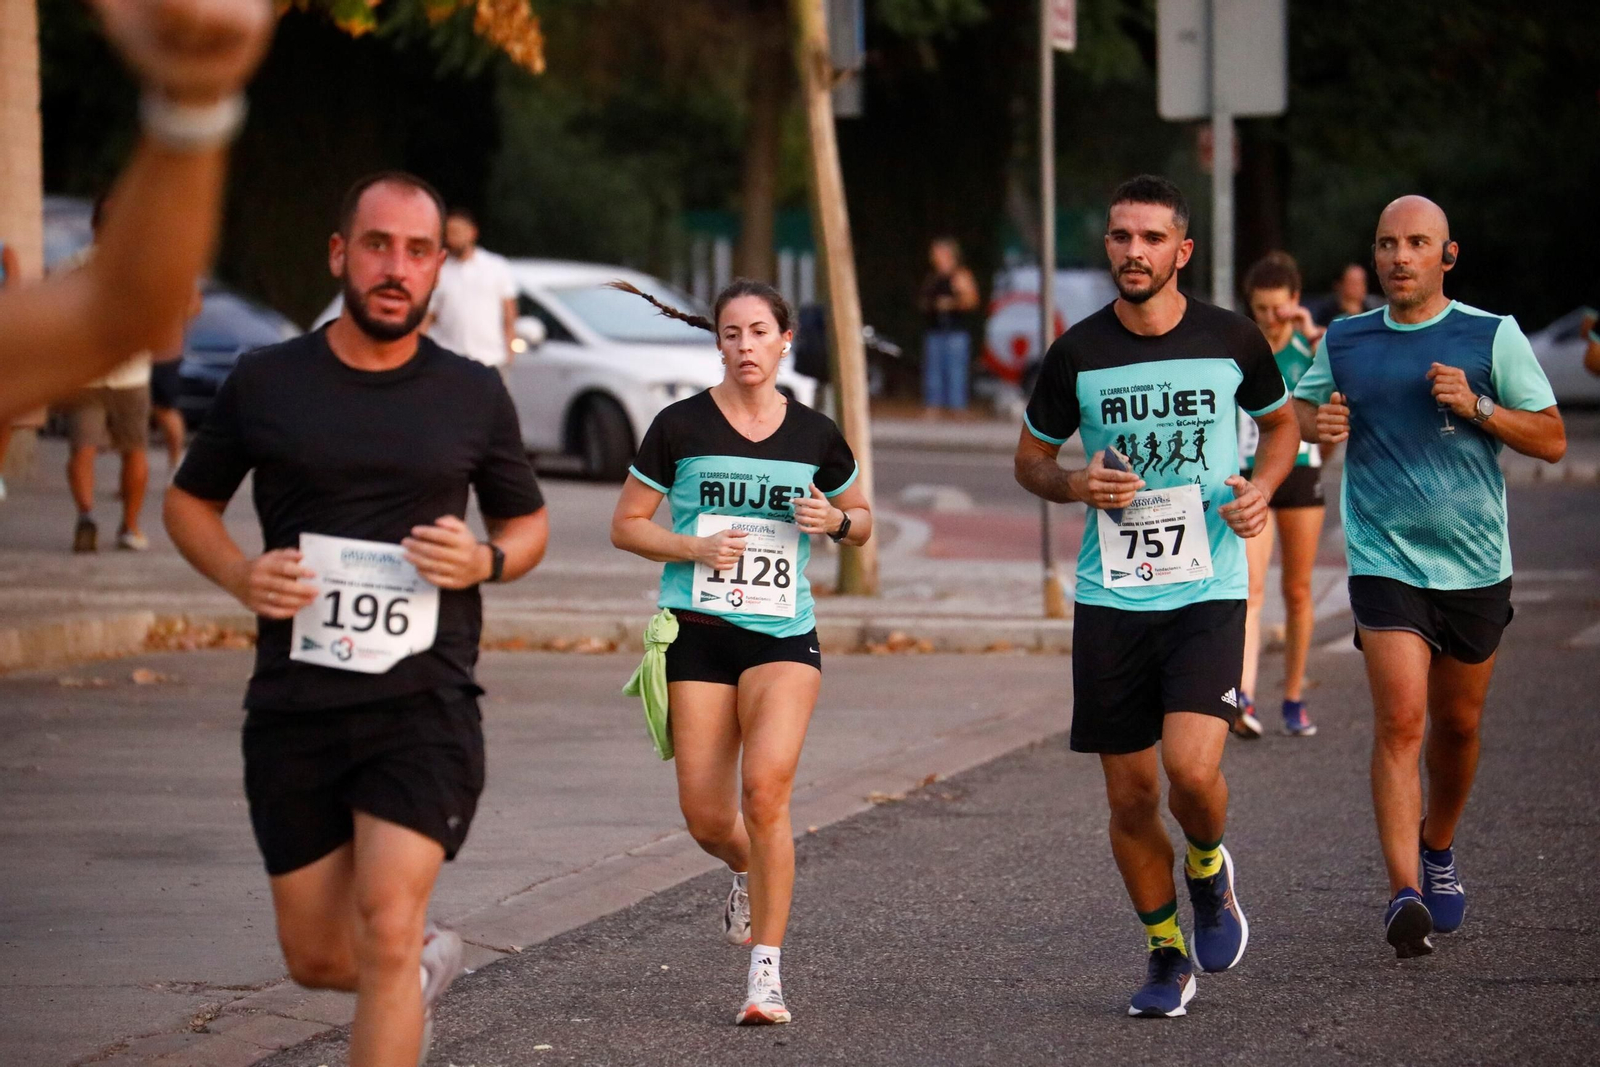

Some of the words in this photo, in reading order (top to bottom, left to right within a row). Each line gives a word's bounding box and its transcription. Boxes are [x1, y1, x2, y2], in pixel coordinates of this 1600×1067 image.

[1100, 389, 1107, 397] XX
[1107, 387, 1130, 396] CARRERA
[1130, 384, 1154, 393] CÓRDOBA
[1101, 389, 1216, 425] MUJER
[1119, 524, 1186, 560] 757
[322, 589, 410, 636] 196
